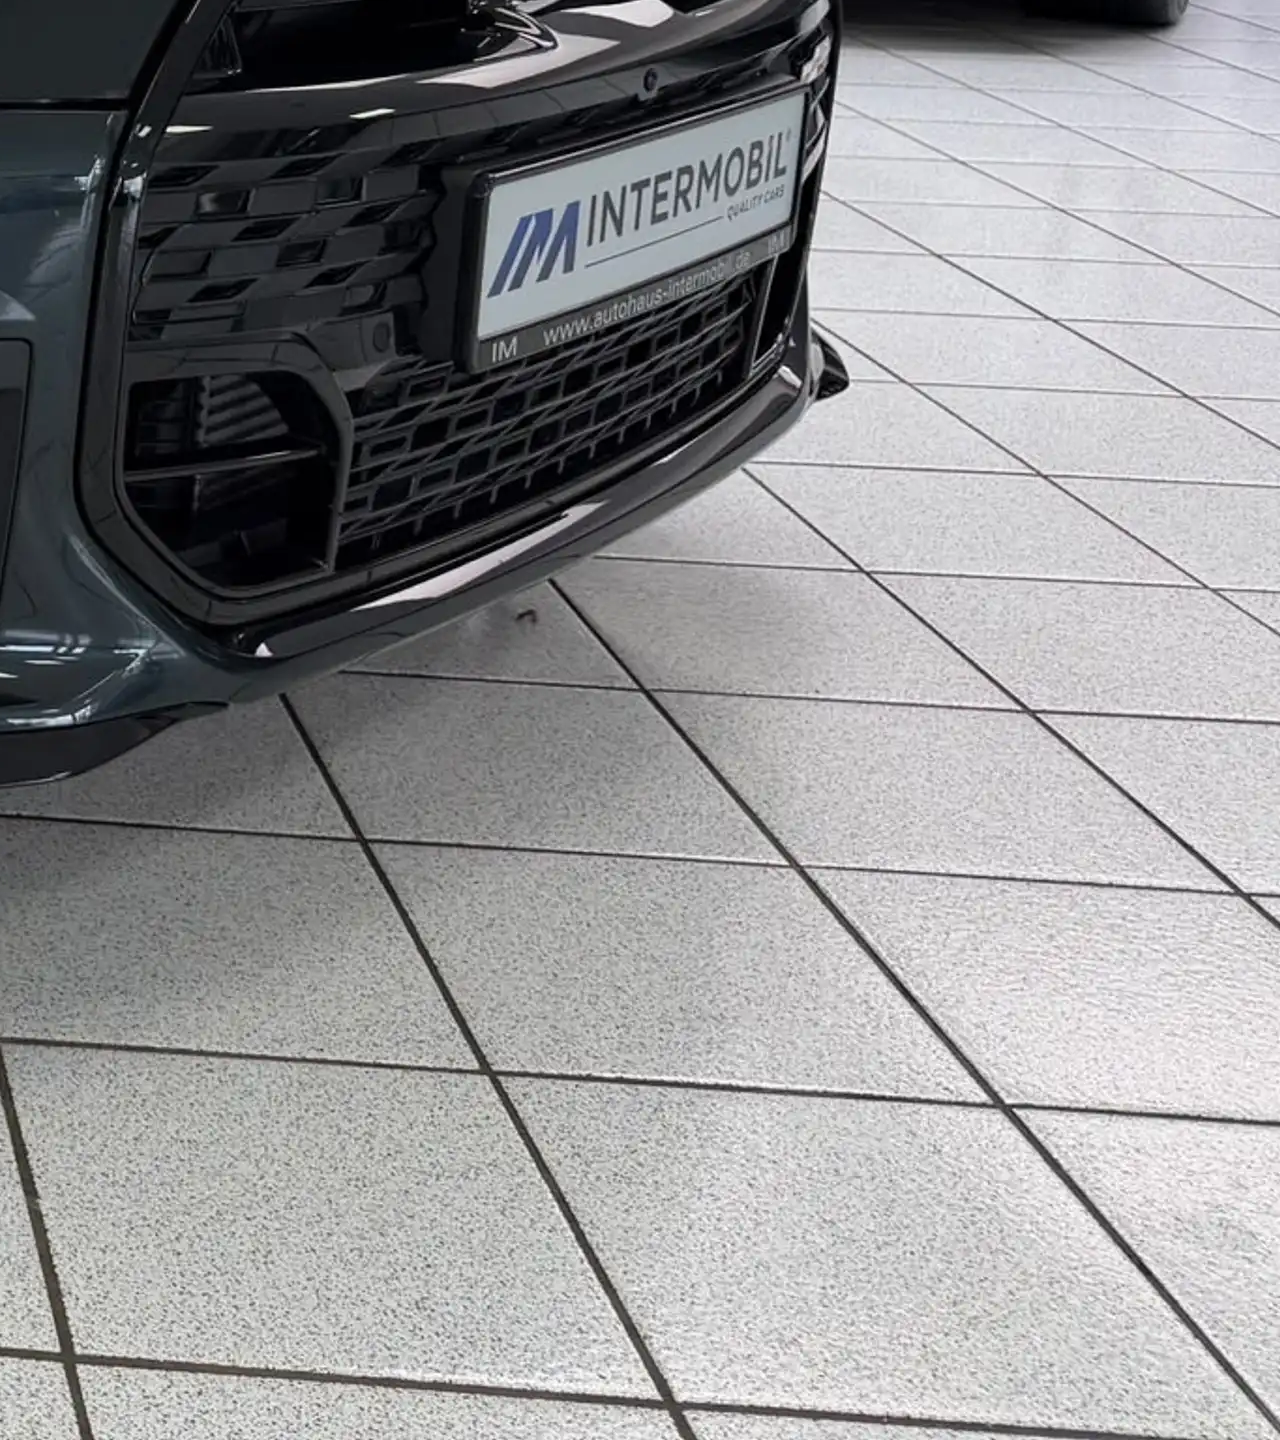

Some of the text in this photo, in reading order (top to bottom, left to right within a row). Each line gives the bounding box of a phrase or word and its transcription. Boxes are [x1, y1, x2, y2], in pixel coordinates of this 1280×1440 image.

[587, 132, 787, 247] INTERMOBIL
[727, 183, 785, 222] QUALITY CARS
[491, 336, 519, 364] IM
[542, 249, 752, 347] www.autohaus-intermobil.de
